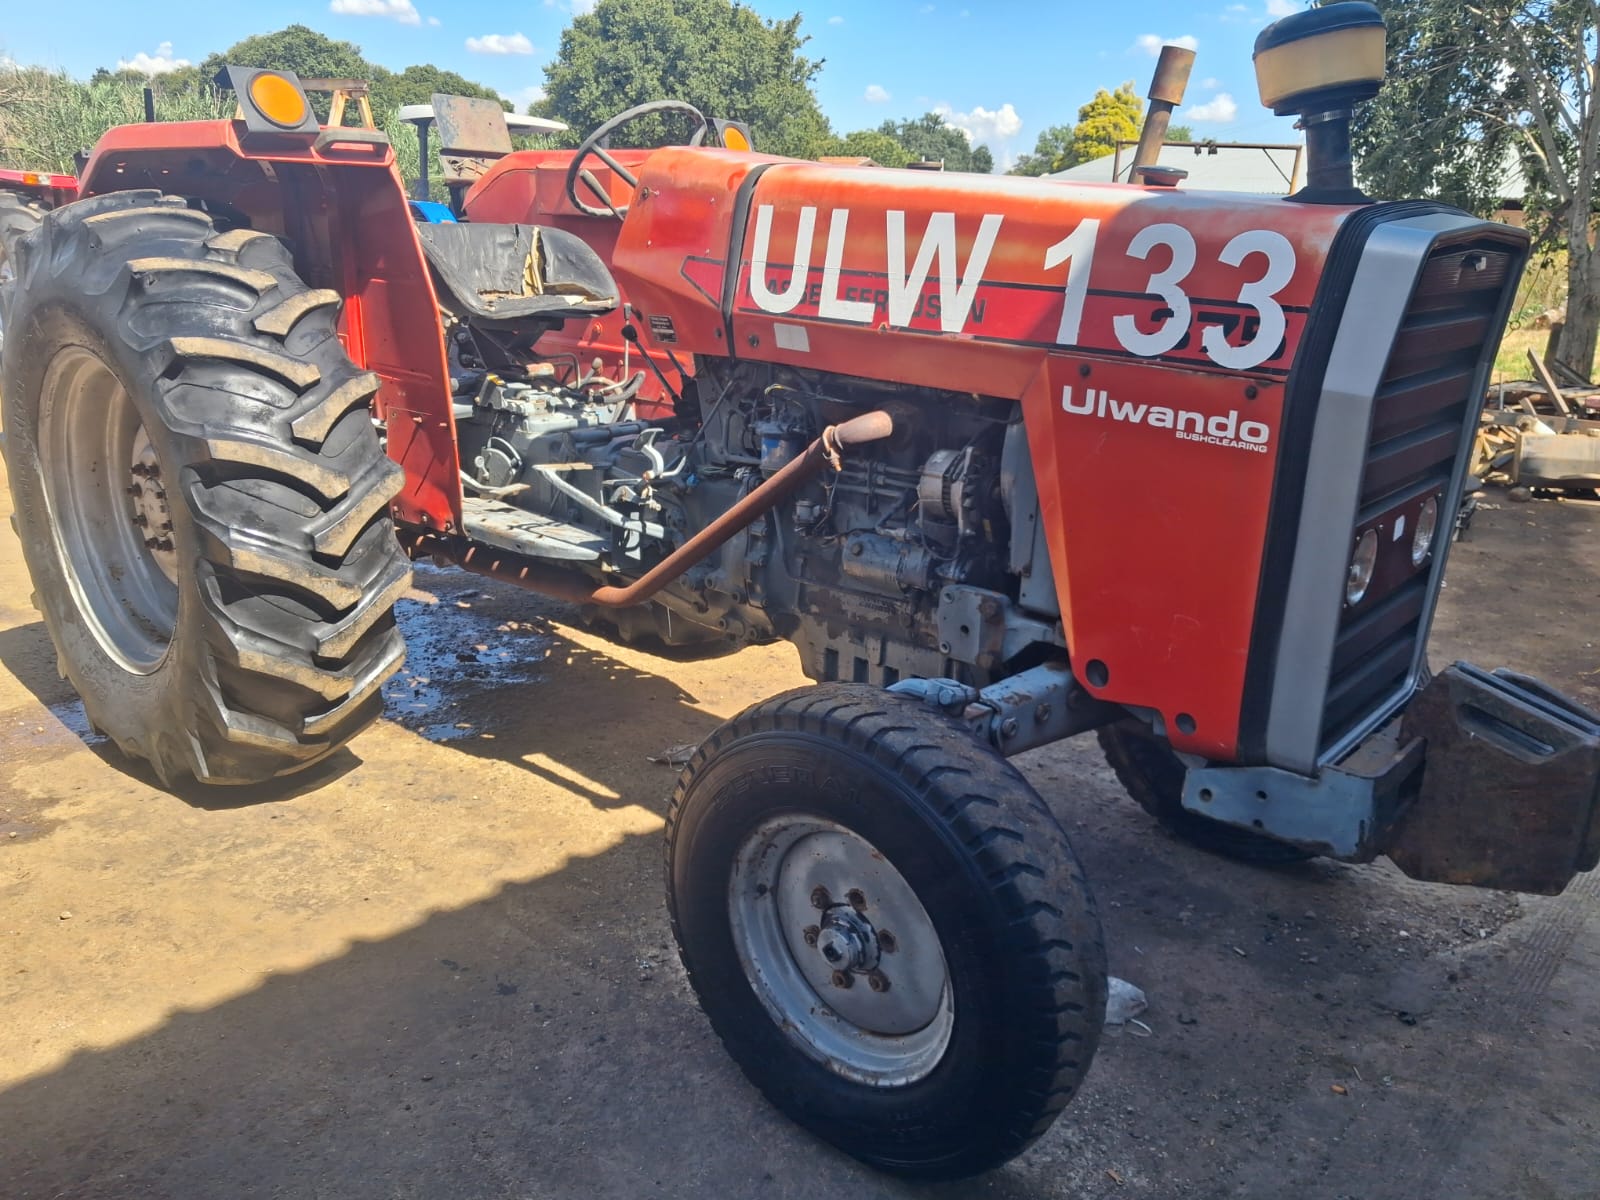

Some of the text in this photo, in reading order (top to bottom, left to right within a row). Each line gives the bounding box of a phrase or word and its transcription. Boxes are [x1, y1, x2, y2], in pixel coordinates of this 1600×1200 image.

[750, 205, 1297, 370] ULW 133
[1061, 385, 1271, 444] Ulwando
[1175, 430, 1269, 454] BUSHCLEARING
